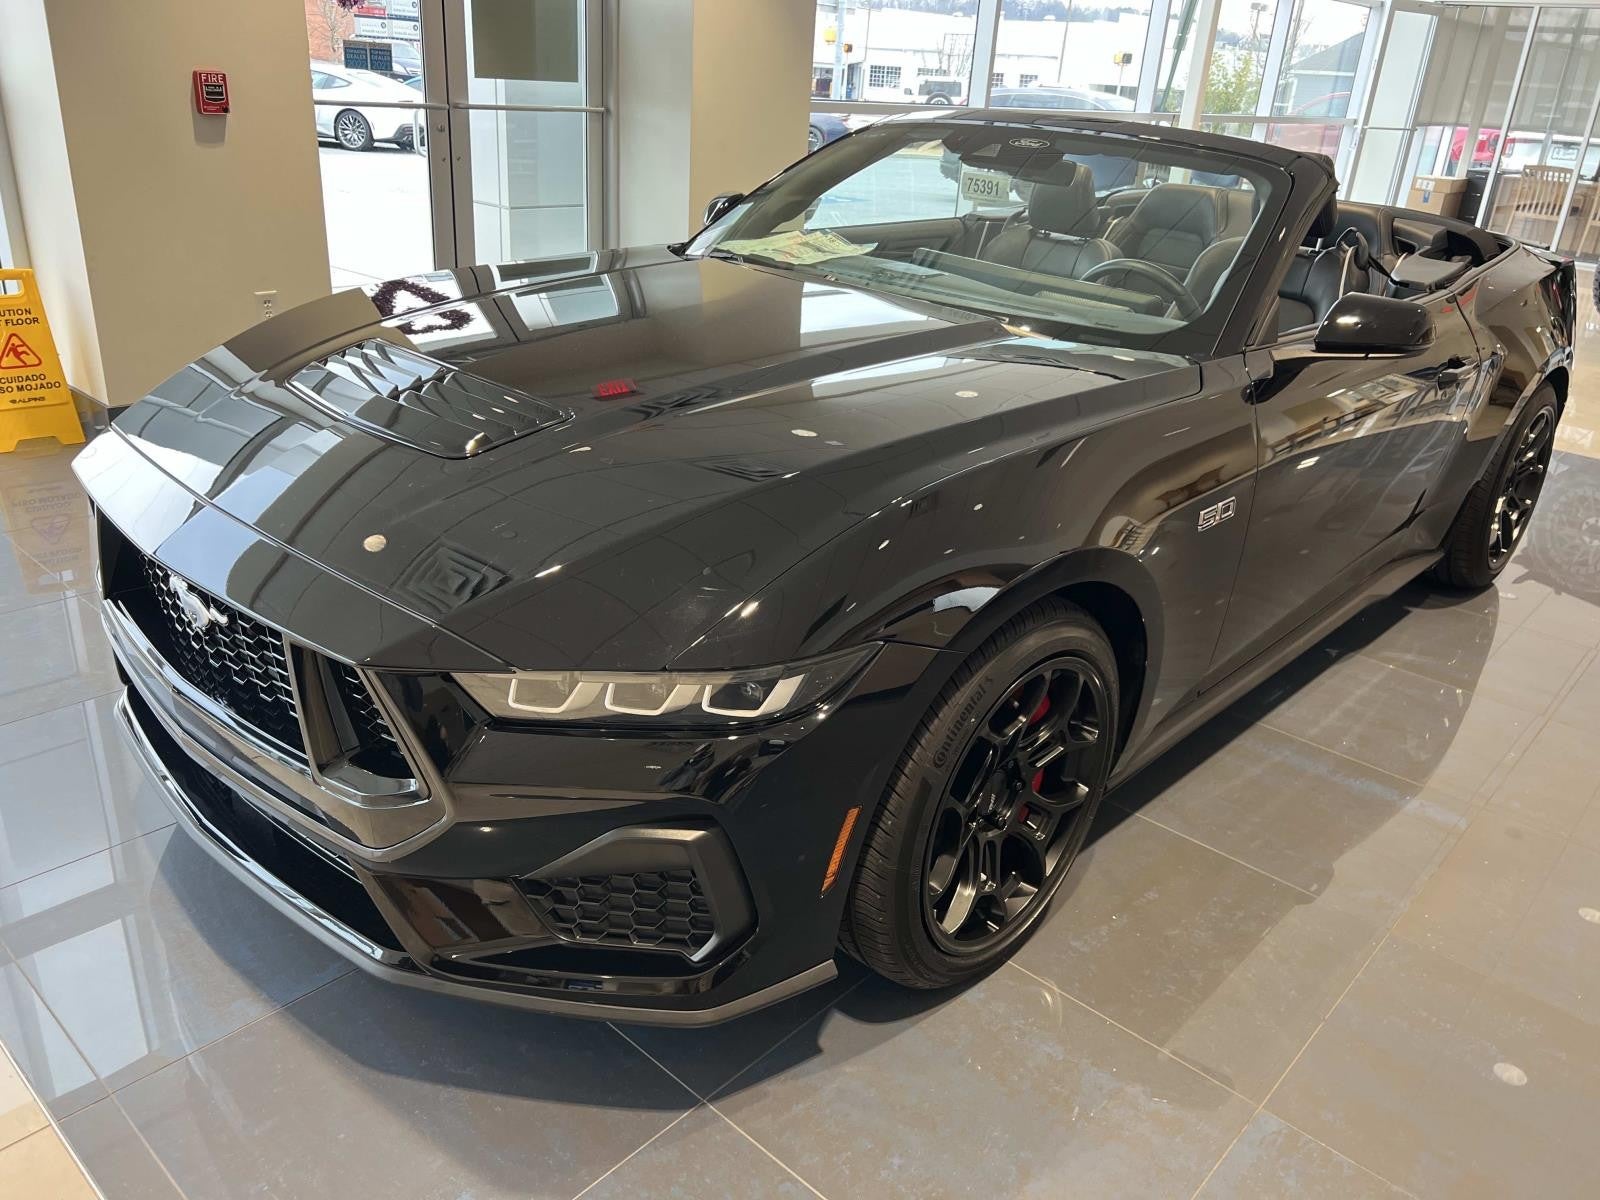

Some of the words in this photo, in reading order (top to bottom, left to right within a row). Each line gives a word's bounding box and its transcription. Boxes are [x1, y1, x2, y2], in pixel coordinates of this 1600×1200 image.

[201, 73, 224, 83] FIRE
[967, 177, 1000, 196] 75391
[5, 317, 40, 327] FLOOR
[0, 373, 46, 385] CUIDADO
[16, 381, 61, 393] MOJADO
